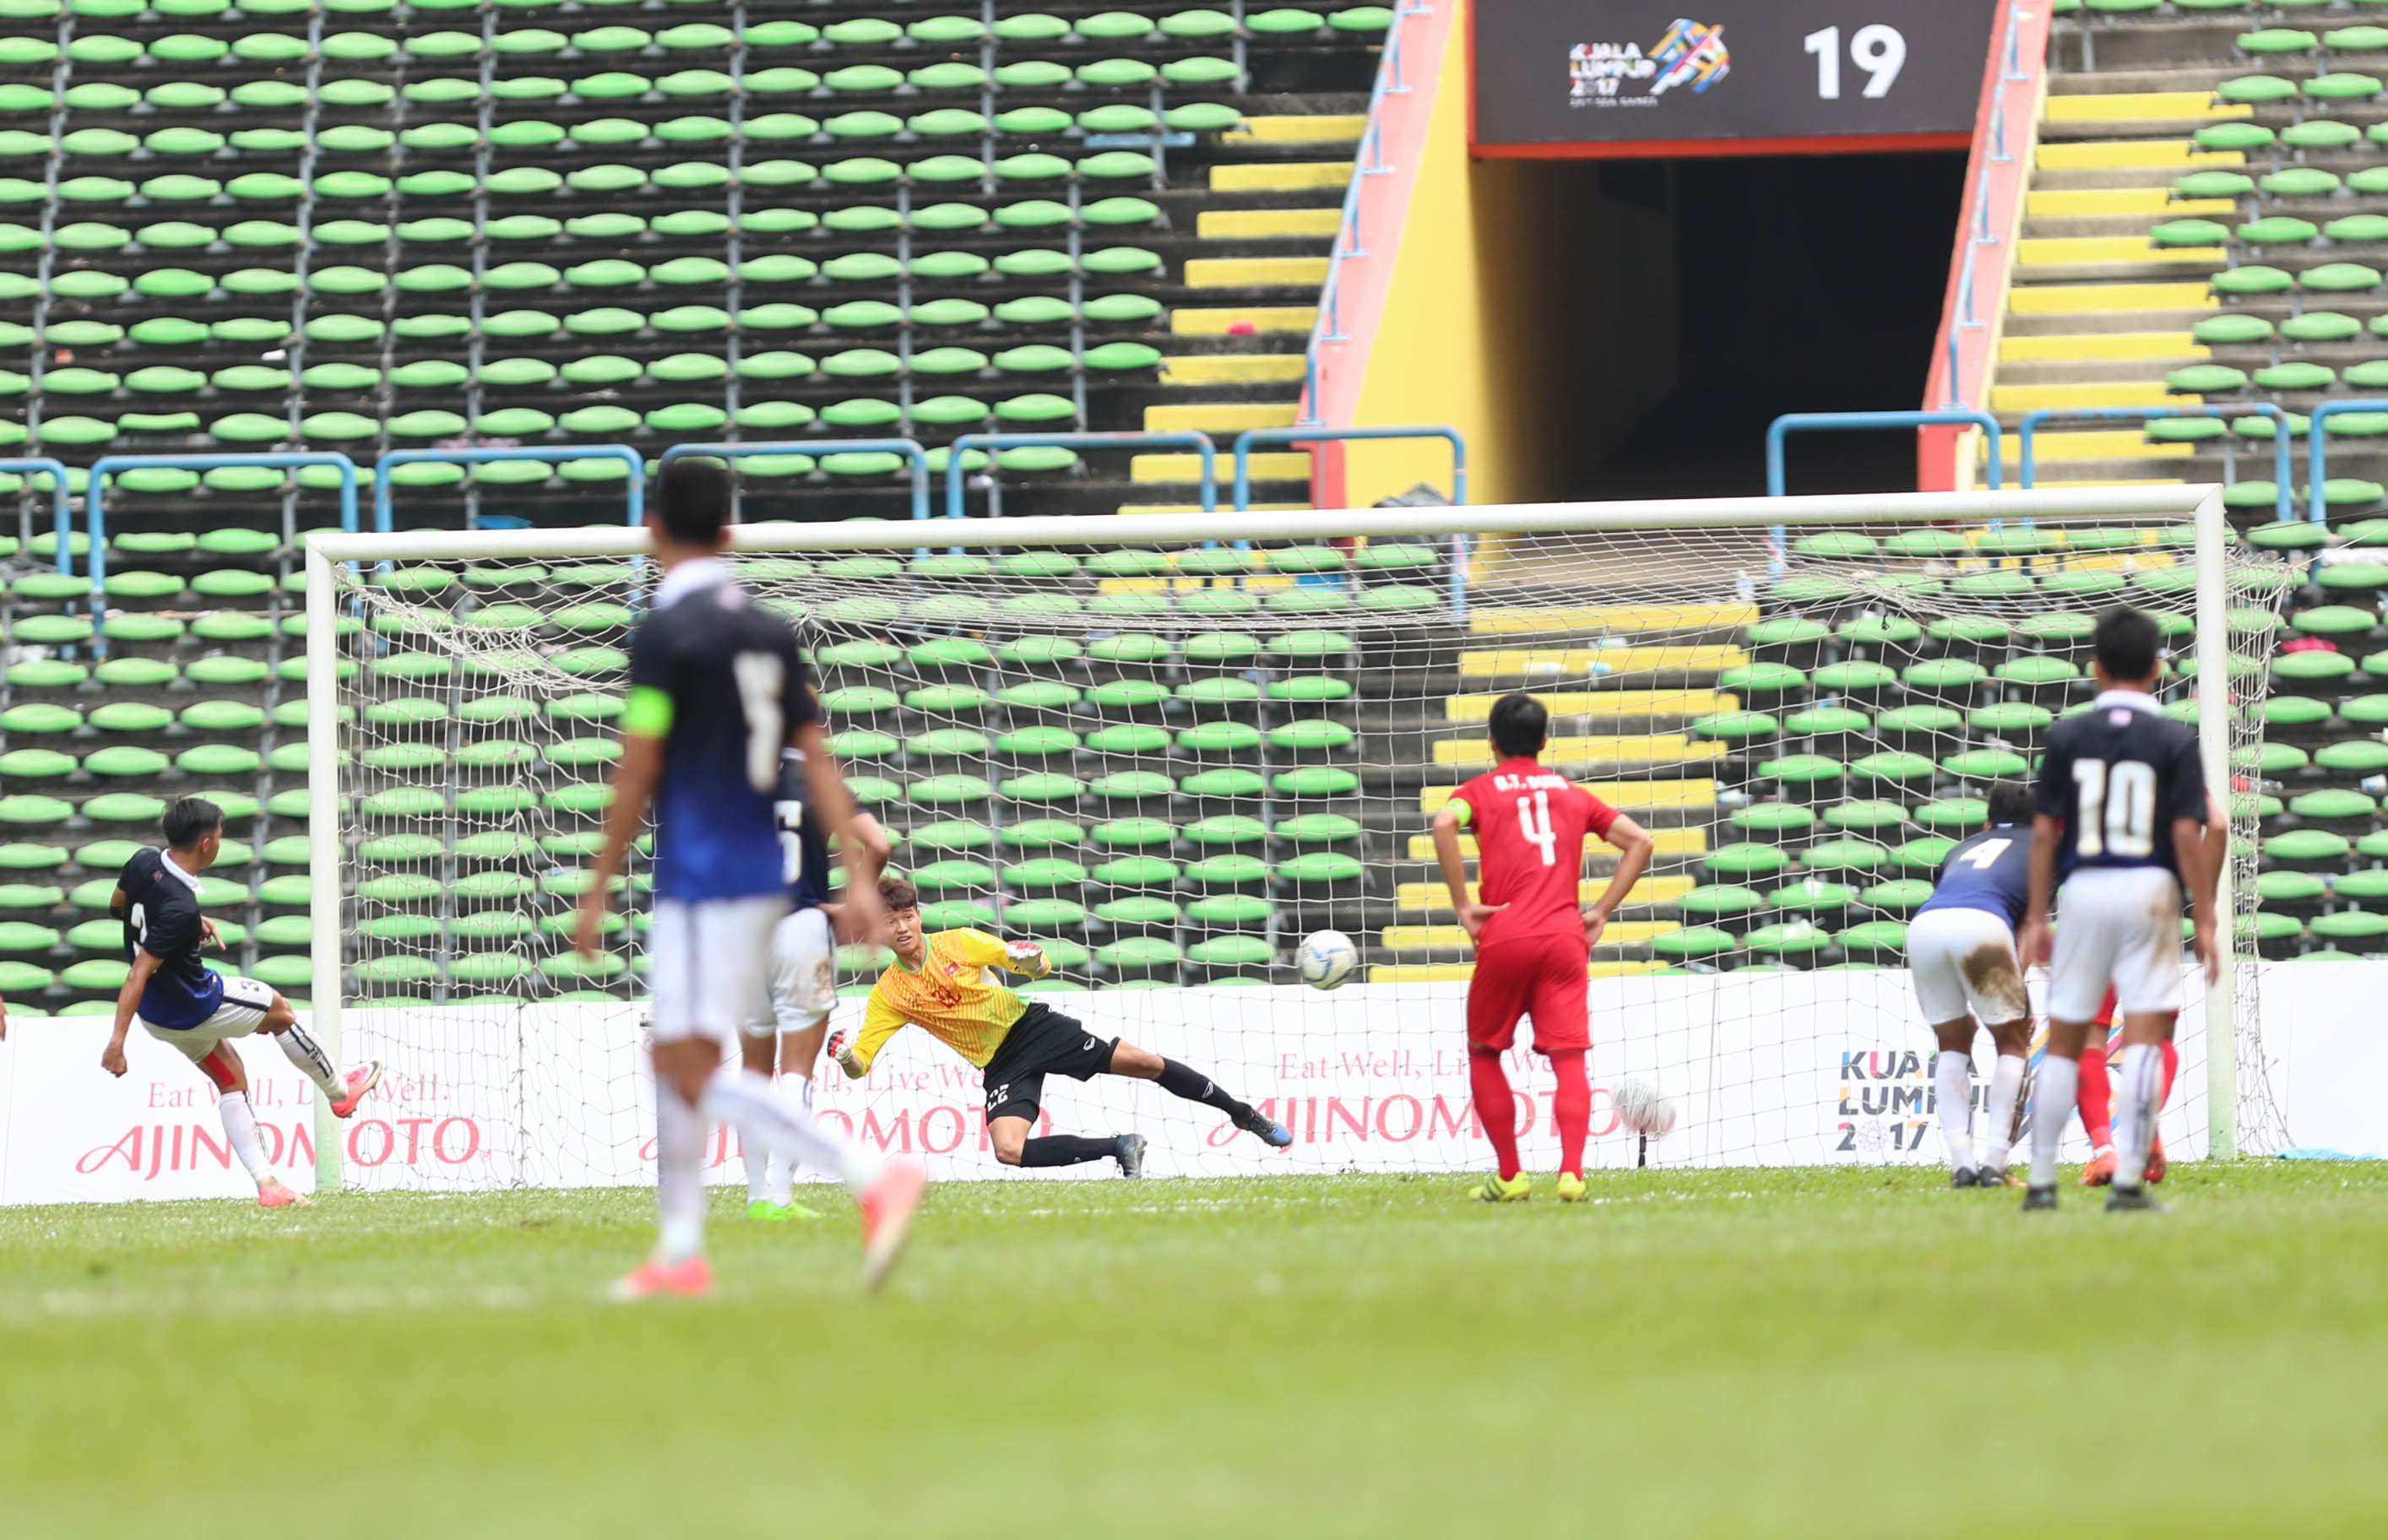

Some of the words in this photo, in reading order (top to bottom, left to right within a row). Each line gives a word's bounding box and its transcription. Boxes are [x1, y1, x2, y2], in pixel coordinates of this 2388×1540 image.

[1569, 42, 1643, 60] KUALA
[1804, 24, 1907, 100] 19
[1569, 59, 1658, 79] LUMPUR
[2071, 757, 2157, 858] 10
[1516, 789, 1557, 866] 4
[1958, 838, 2013, 870] 4
[866, 1064, 930, 1092] Live
[1278, 1053, 1332, 1080] Eat
[1341, 1049, 1422, 1081] Well,
[147, 1082, 196, 1109] Eat
